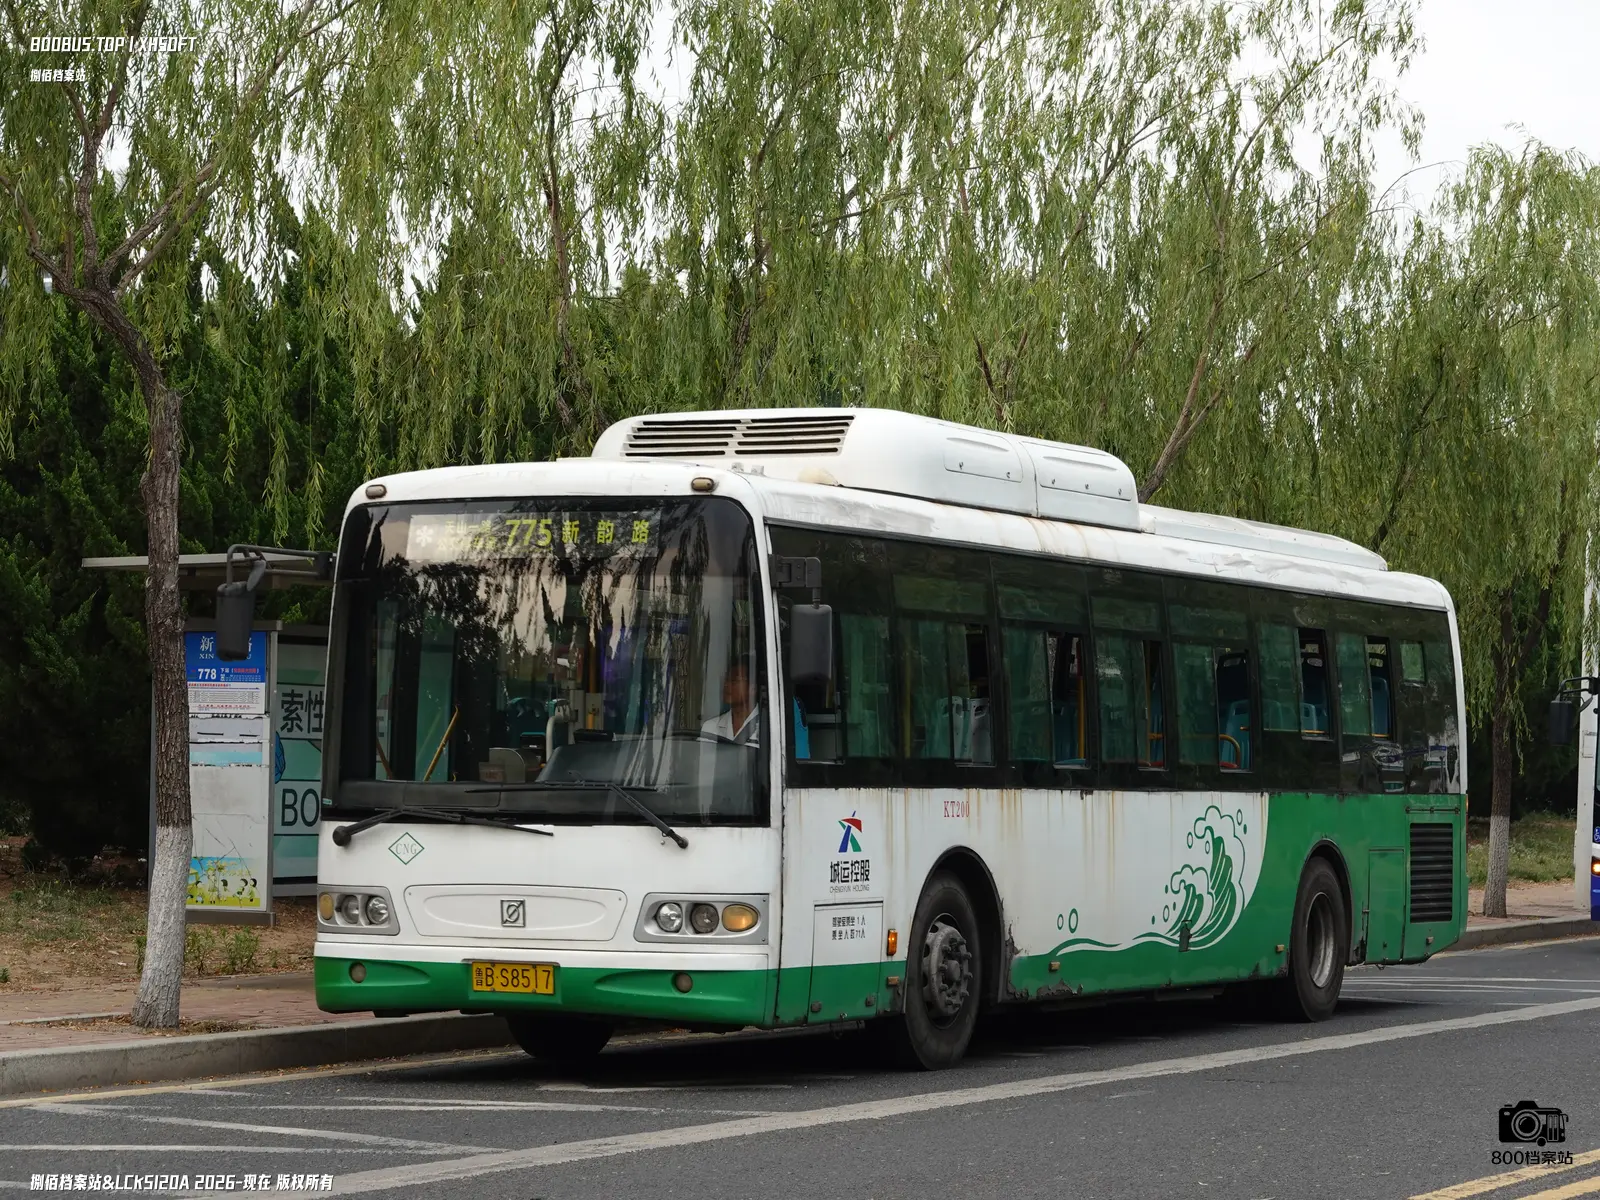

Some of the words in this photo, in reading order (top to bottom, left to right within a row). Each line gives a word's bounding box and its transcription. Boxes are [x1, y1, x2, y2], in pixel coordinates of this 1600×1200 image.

[505, 518, 553, 547] 775
[197, 668, 217, 680] 778
[281, 788, 320, 828] BO
[943, 801, 970, 818] KT200
[395, 843, 417, 855] CNG
[829, 859, 870, 884] 城运控股
